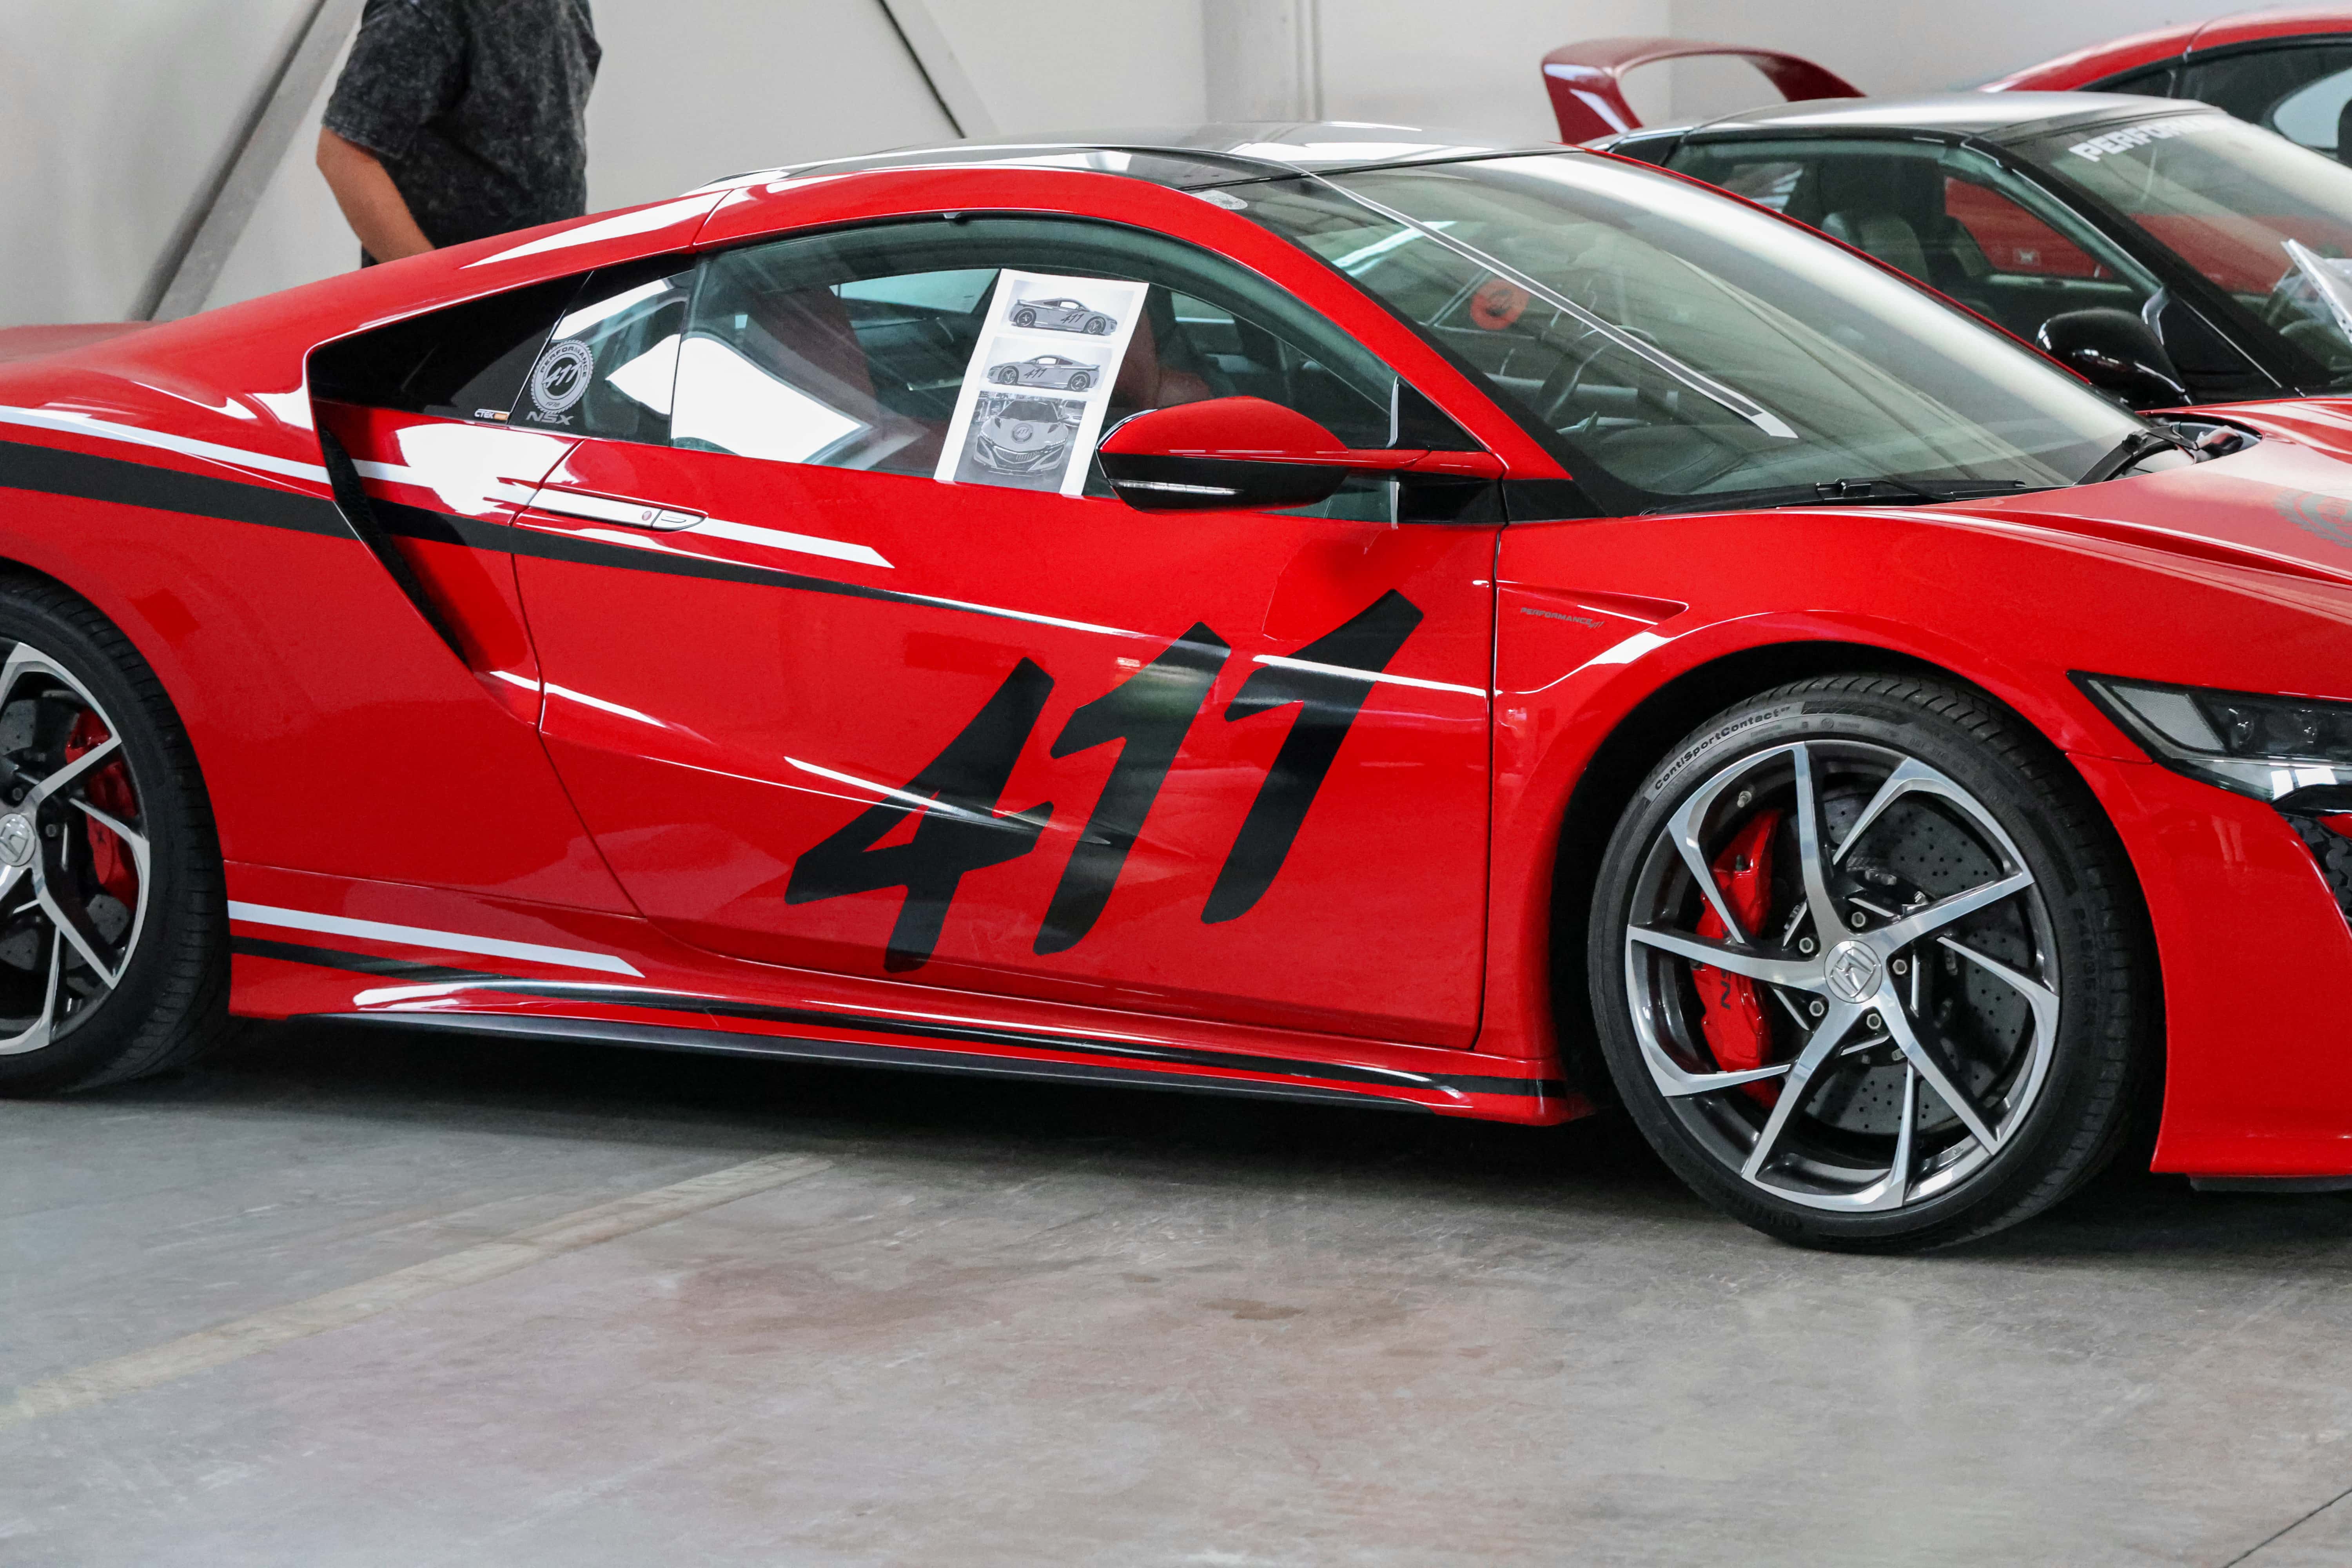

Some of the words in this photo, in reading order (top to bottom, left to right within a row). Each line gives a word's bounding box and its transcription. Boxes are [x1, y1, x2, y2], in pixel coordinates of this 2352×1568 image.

[1060, 313, 1084, 324] 411
[540, 346, 587, 377] PERFORMANCE
[541, 360, 583, 389] 411
[1024, 368, 1048, 379] 411
[474, 410, 494, 419] CTEK
[526, 411, 574, 425] NSX
[1520, 607, 1593, 625] PERFORMANCE
[1655, 708, 1779, 790] ContiSportContact
[784, 589, 1424, 973] 411
